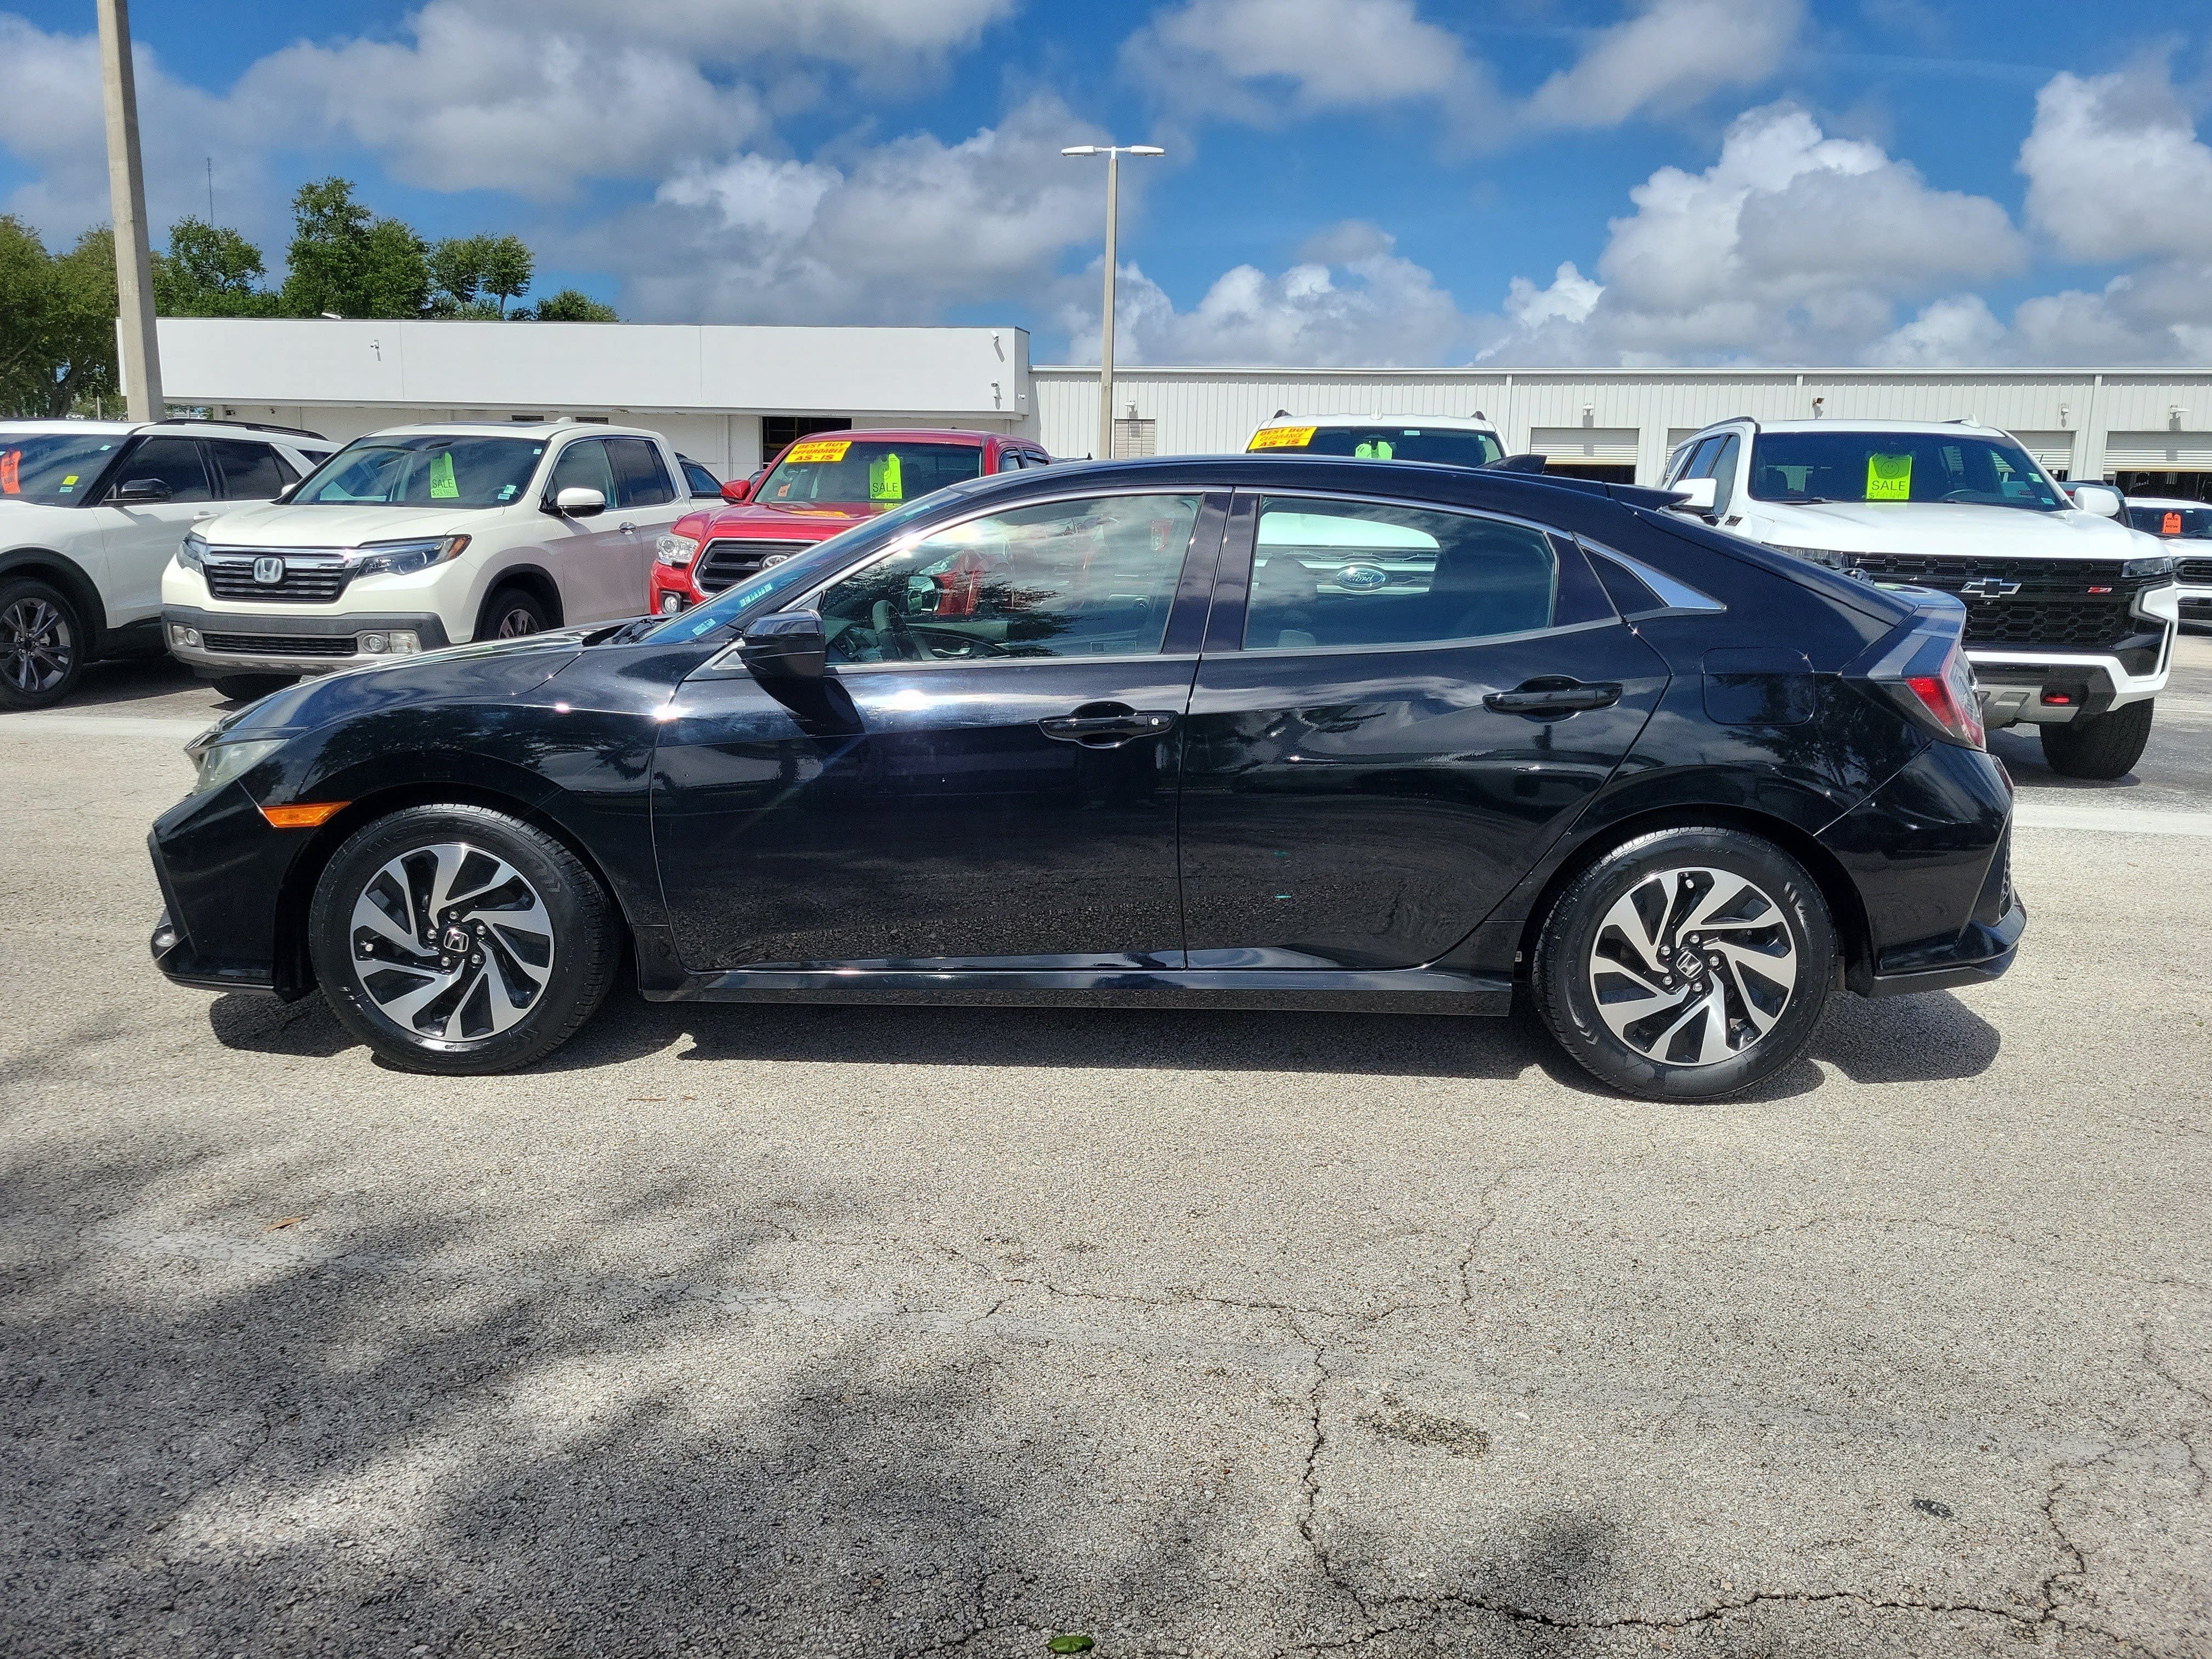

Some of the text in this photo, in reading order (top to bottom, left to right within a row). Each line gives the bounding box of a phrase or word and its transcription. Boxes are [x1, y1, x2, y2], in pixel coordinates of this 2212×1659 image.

[432, 478, 454, 489] SALE
[873, 483, 898, 492] SALE
[1871, 480, 1906, 490] SALE
